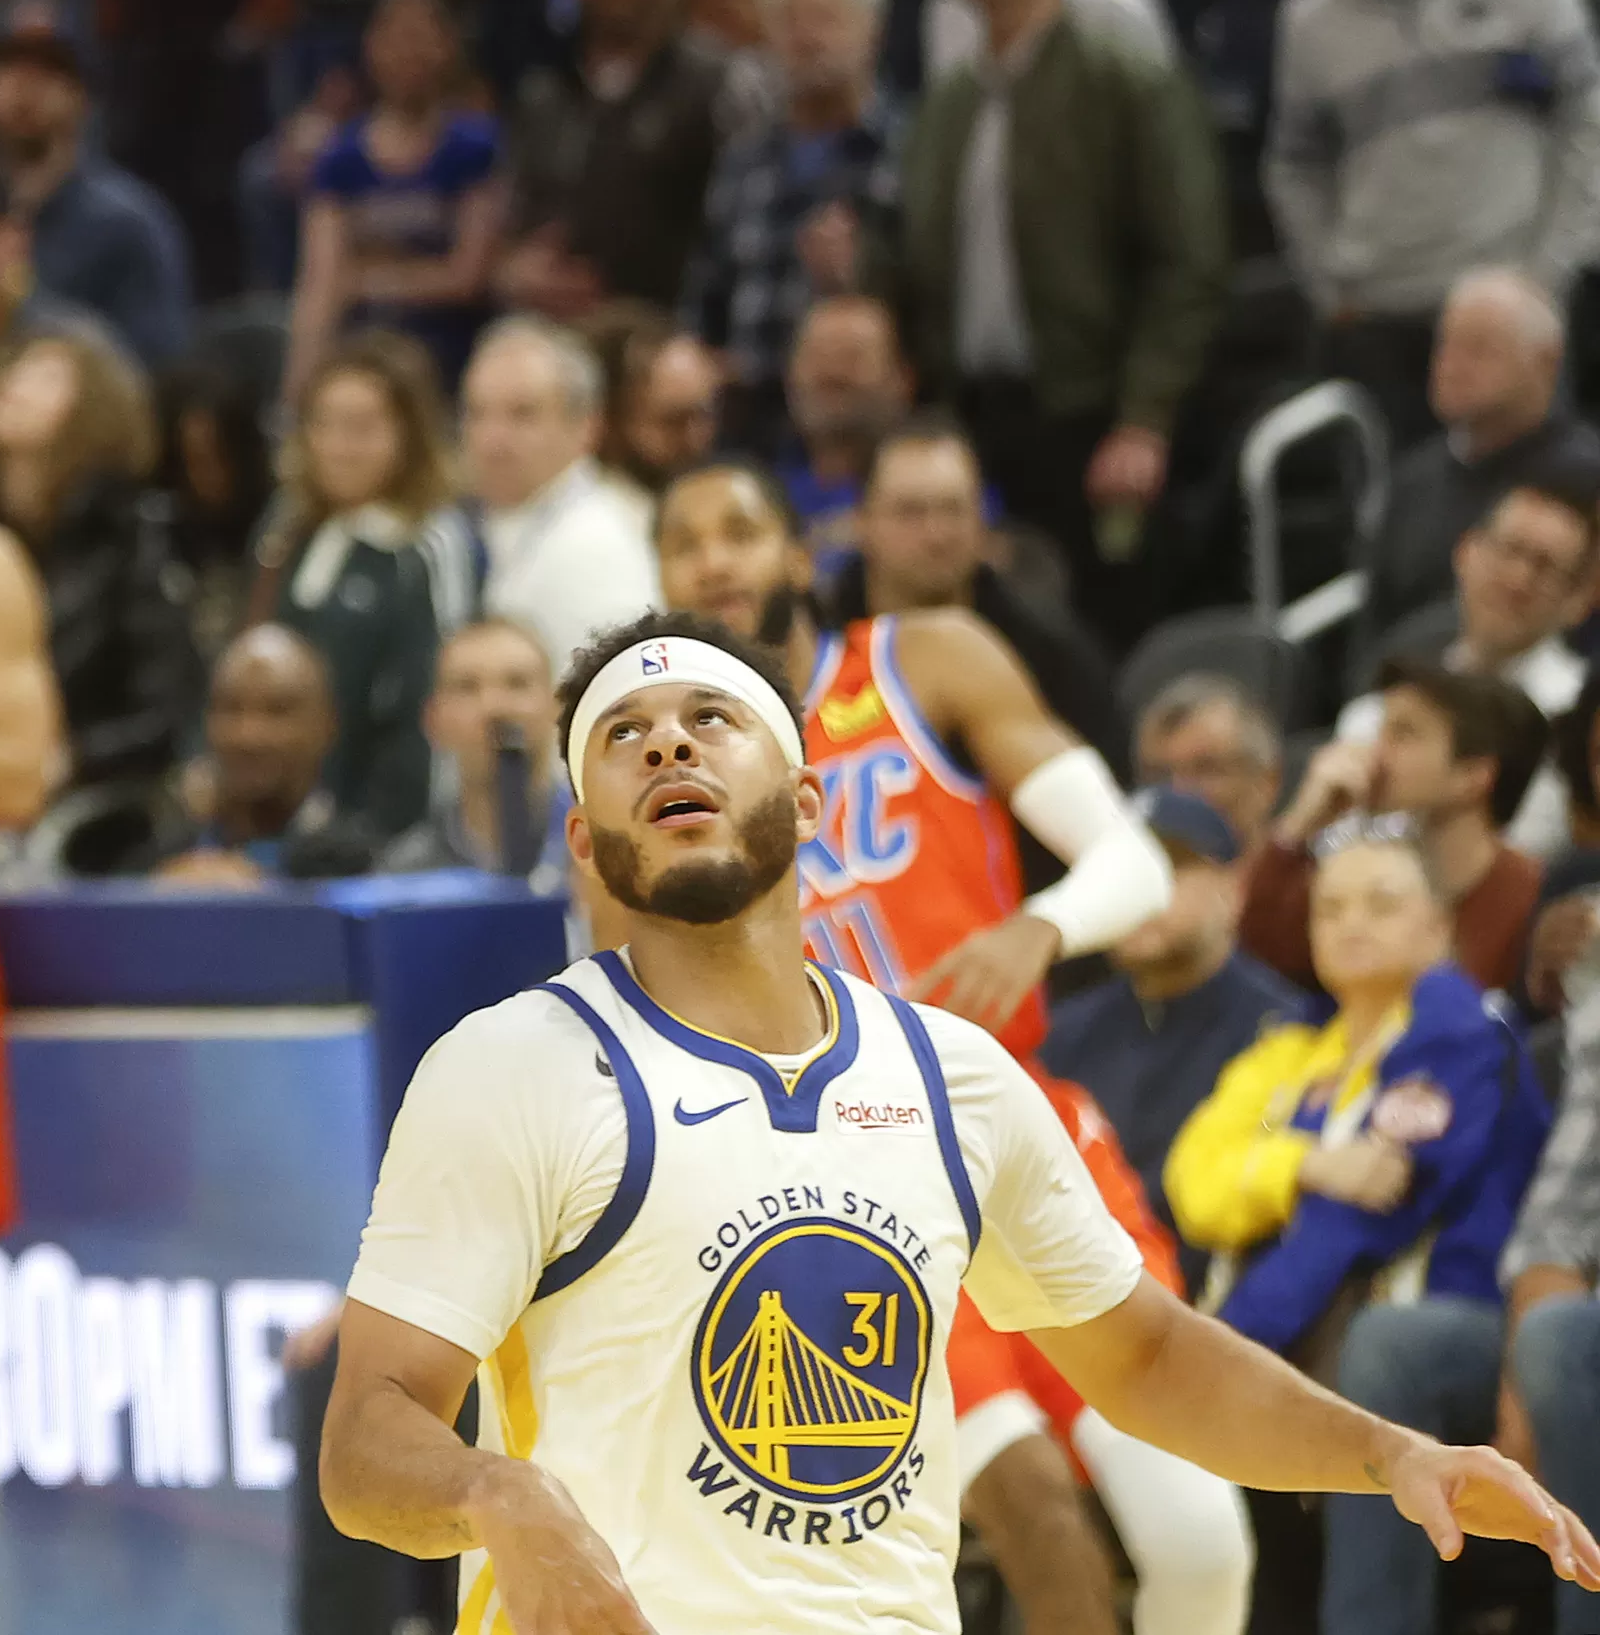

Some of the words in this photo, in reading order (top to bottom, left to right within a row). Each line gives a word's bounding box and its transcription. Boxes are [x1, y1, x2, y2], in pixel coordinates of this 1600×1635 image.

[835, 1101, 925, 1126] Rakuten
[697, 1186, 824, 1273] GOLDEN
[843, 1191, 932, 1271] STATE
[841, 1292, 900, 1367] 31
[685, 1442, 926, 1545] WARRIORS
